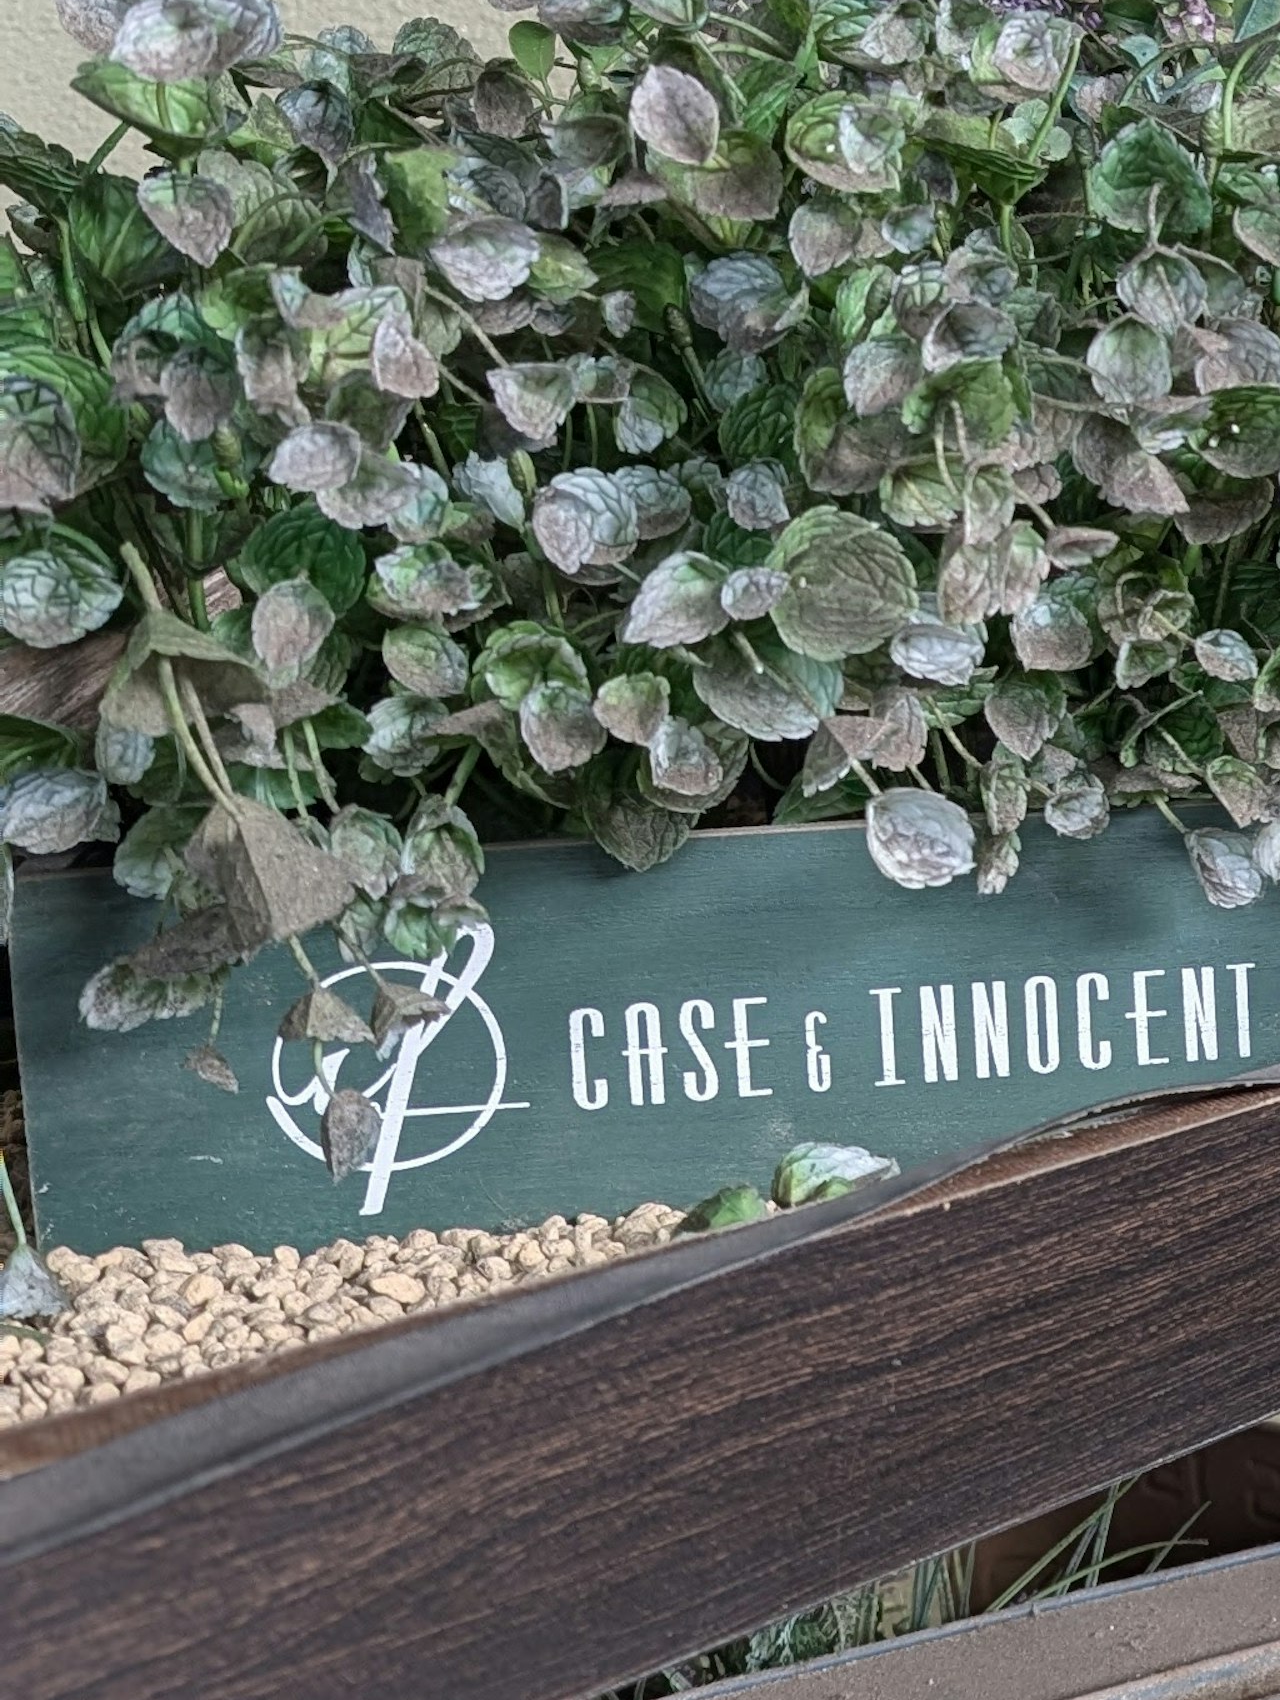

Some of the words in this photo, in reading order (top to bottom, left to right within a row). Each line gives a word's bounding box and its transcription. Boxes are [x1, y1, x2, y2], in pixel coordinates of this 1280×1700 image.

[569, 995, 774, 1110] CASE
[805, 1009, 831, 1092] &
[869, 962, 1257, 1087] INNOCENT
